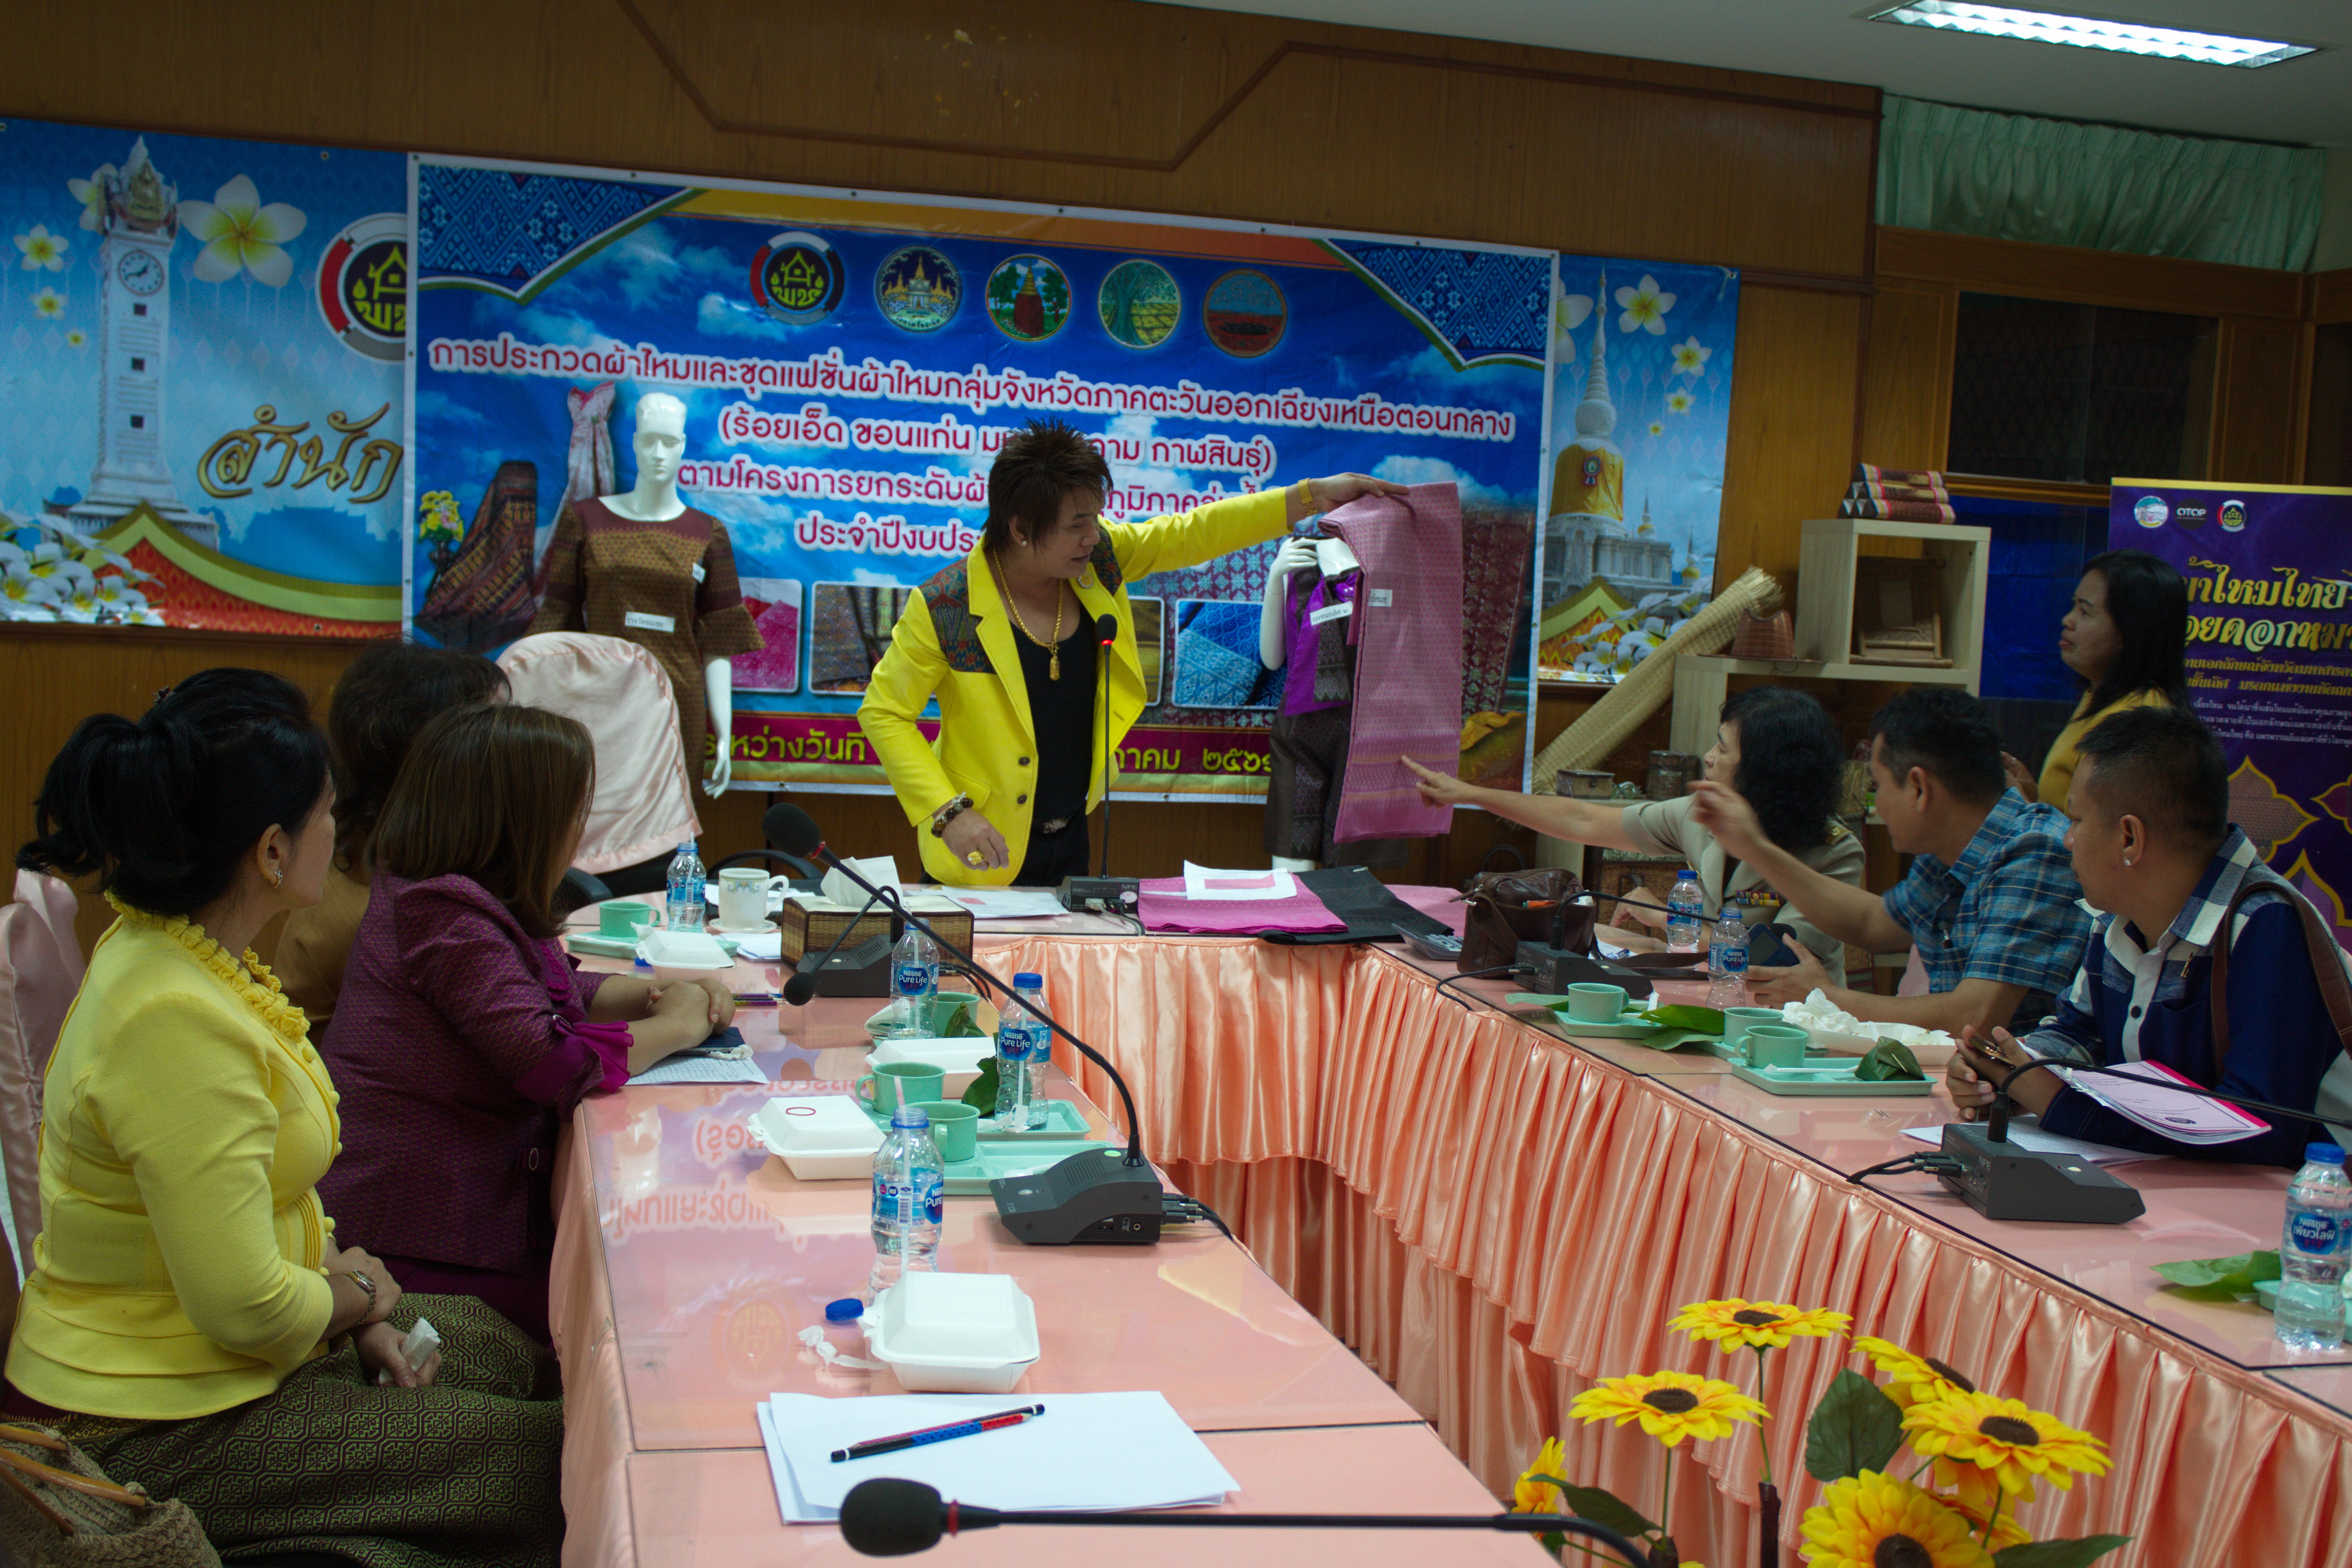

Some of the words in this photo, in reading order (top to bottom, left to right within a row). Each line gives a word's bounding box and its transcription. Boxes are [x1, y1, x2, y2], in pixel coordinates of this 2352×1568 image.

[723, 407, 843, 441] (ร้อยเอ็ด
[856, 420, 970, 451] ขอนแก่น
[2176, 508, 2206, 517] OTOP
[899, 975, 915, 983] Pure
[916, 976, 927, 986] Life
[1001, 1036, 1015, 1047] Pure
[1016, 1040, 1030, 1051] Life
